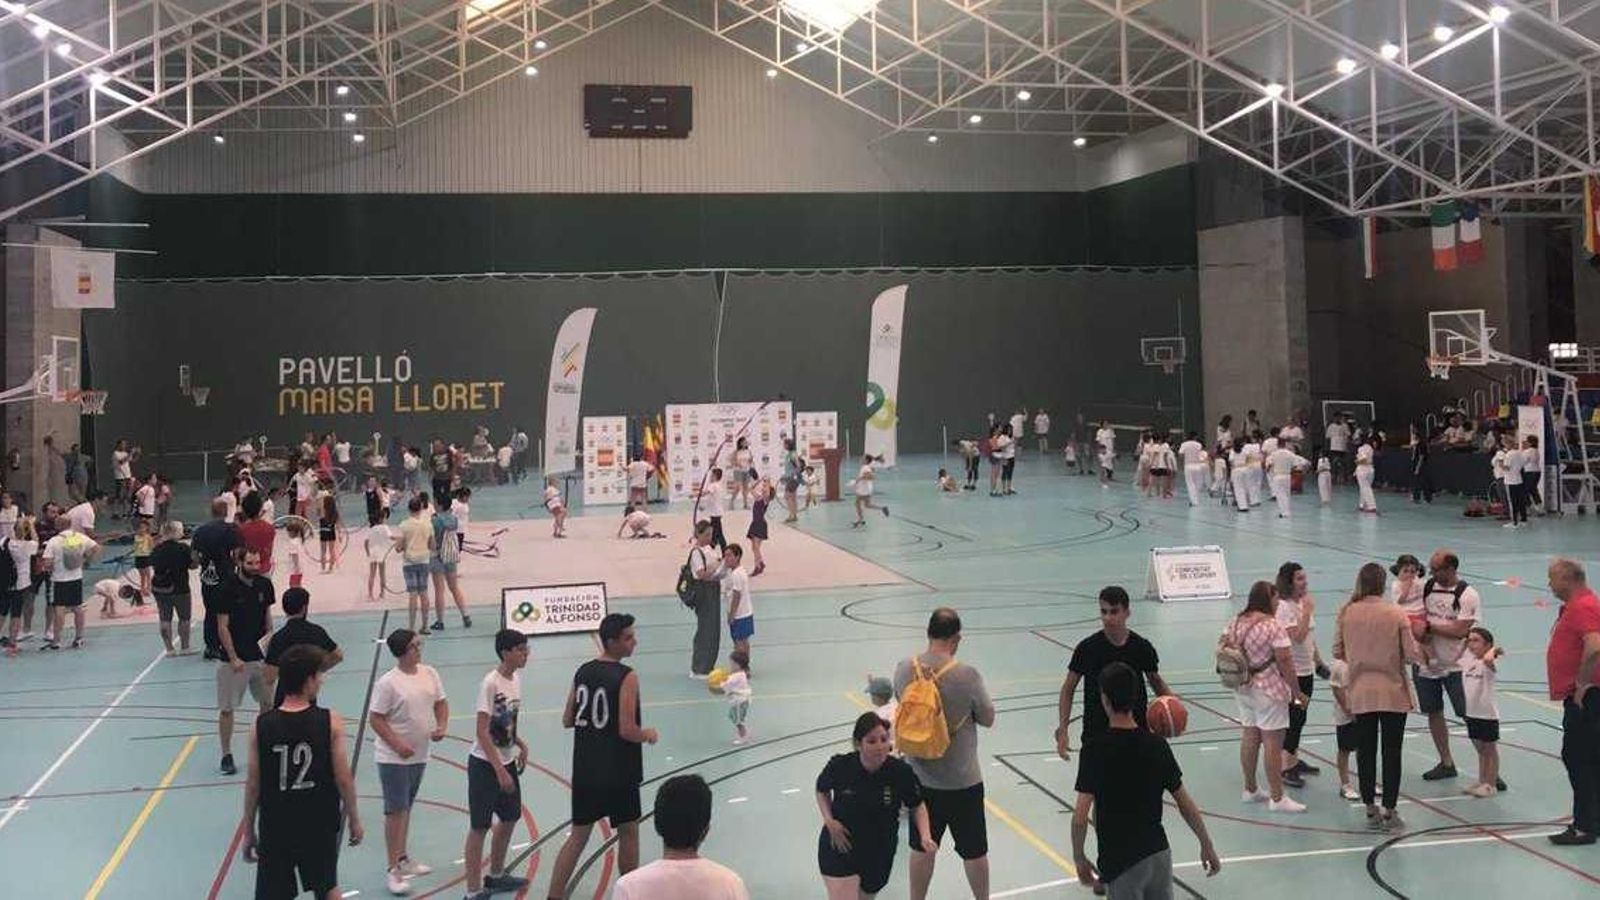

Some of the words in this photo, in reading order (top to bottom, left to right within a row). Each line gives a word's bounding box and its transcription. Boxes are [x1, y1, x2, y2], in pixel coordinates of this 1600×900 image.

[279, 350, 412, 385] PAVELLÓ
[394, 382, 505, 413] LLORET
[544, 602, 600, 614] TRINIDAD
[546, 612, 600, 624] ALFONSO
[575, 684, 609, 729] 20
[272, 742, 314, 791] 12
